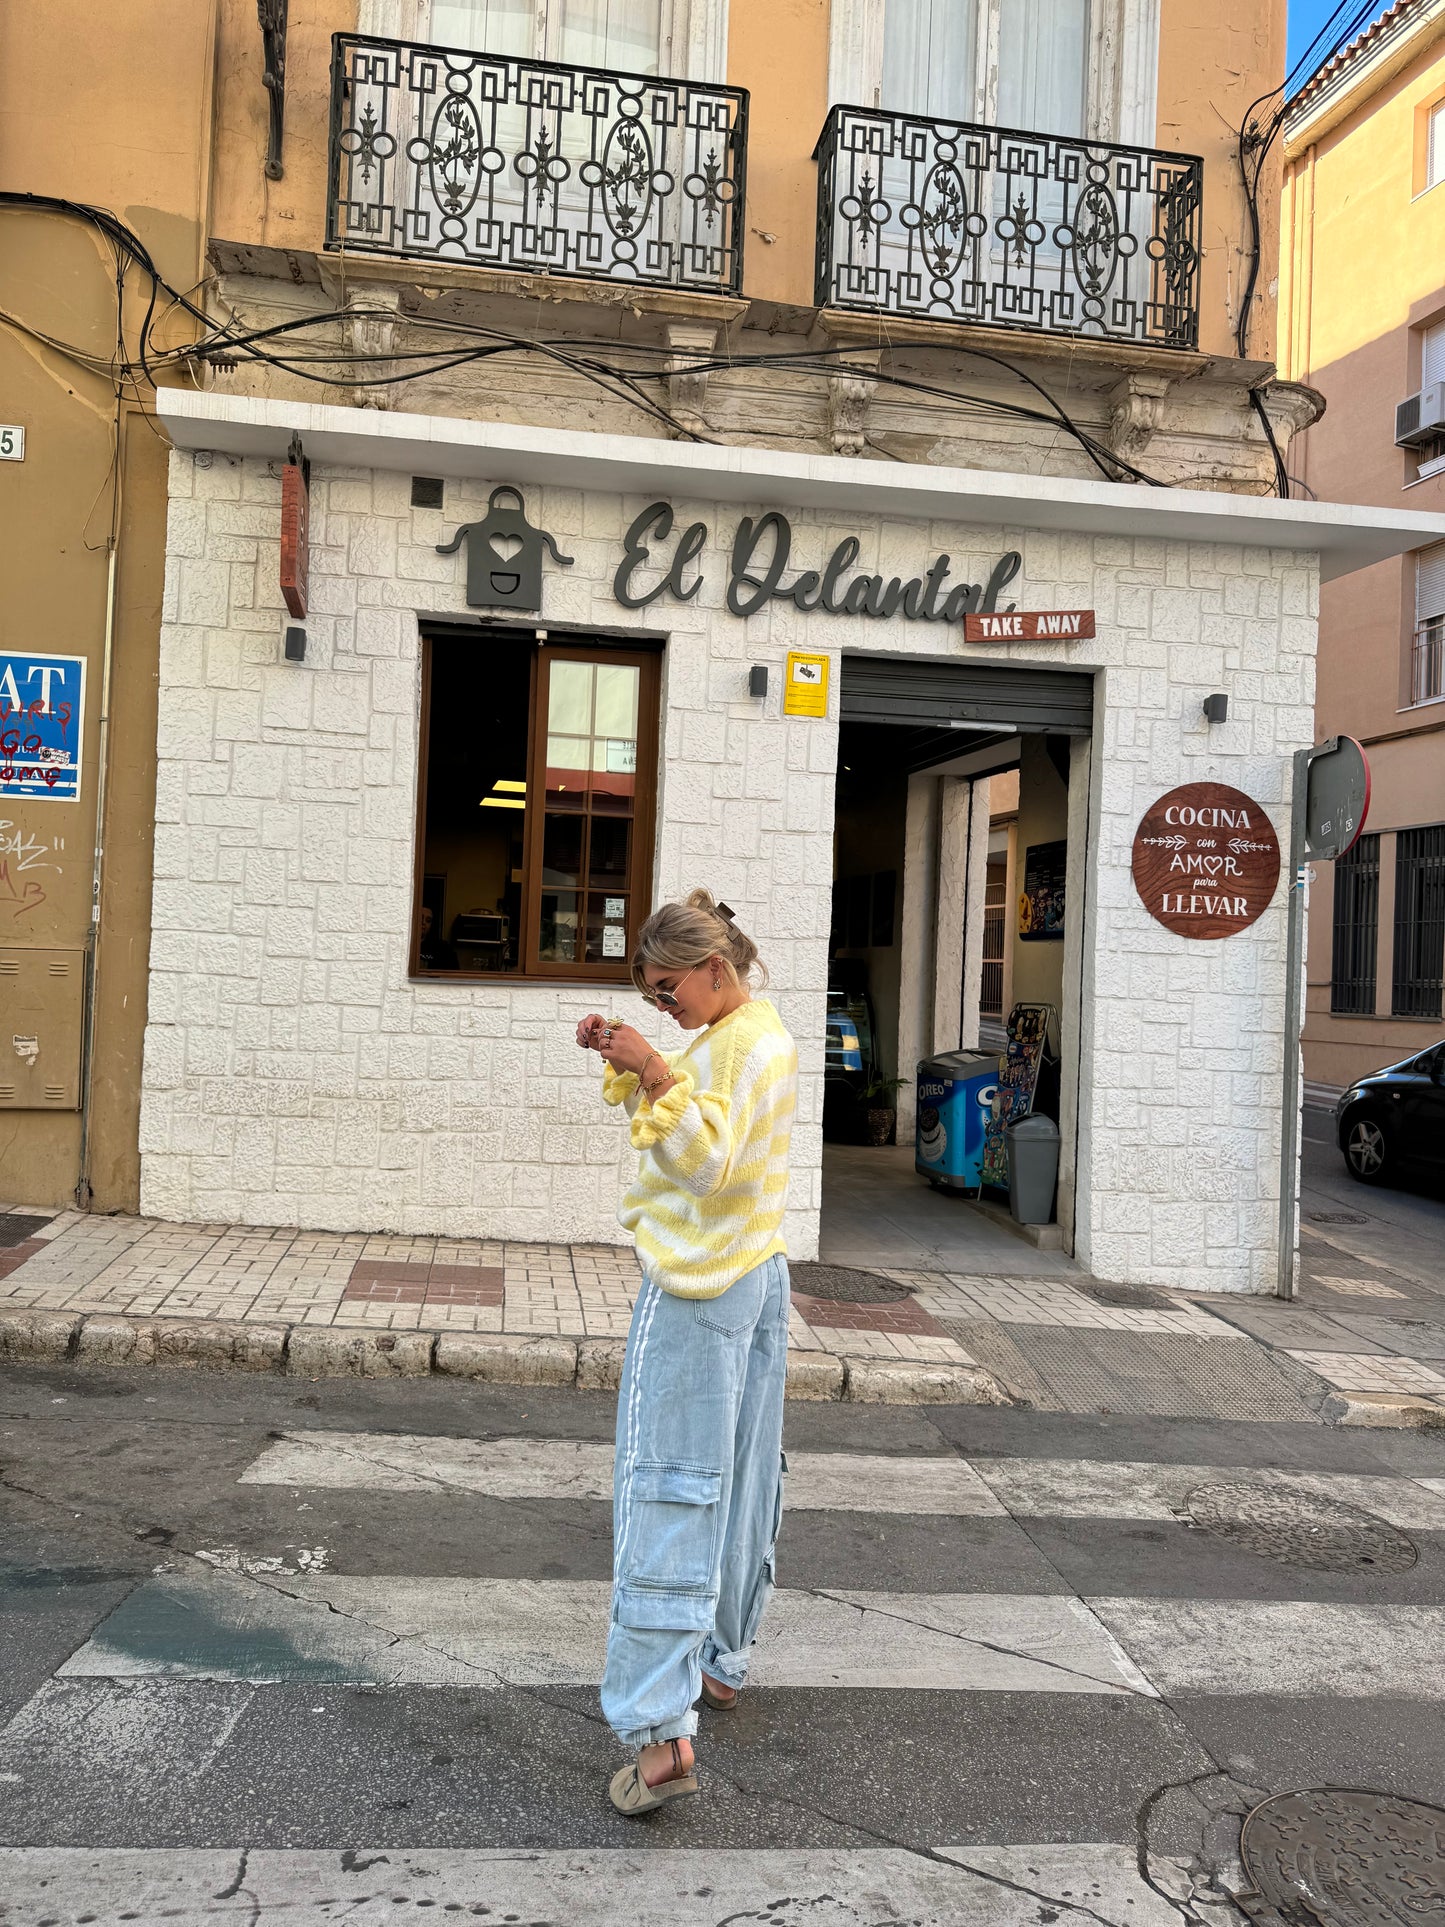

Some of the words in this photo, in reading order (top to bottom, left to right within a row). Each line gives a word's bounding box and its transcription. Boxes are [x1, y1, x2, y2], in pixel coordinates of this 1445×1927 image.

[614, 501, 708, 609] El
[727, 511, 1022, 622] Delantal
[980, 616, 1023, 637] TAKE
[1036, 614, 1081, 635] AWAY
[1164, 806, 1251, 829] COCINA
[1196, 837, 1217, 848] con
[1170, 853, 1243, 877] AMOR
[1193, 877, 1218, 890] para
[1161, 893, 1249, 917] LLEVAR
[919, 1083, 945, 1101] OREO
